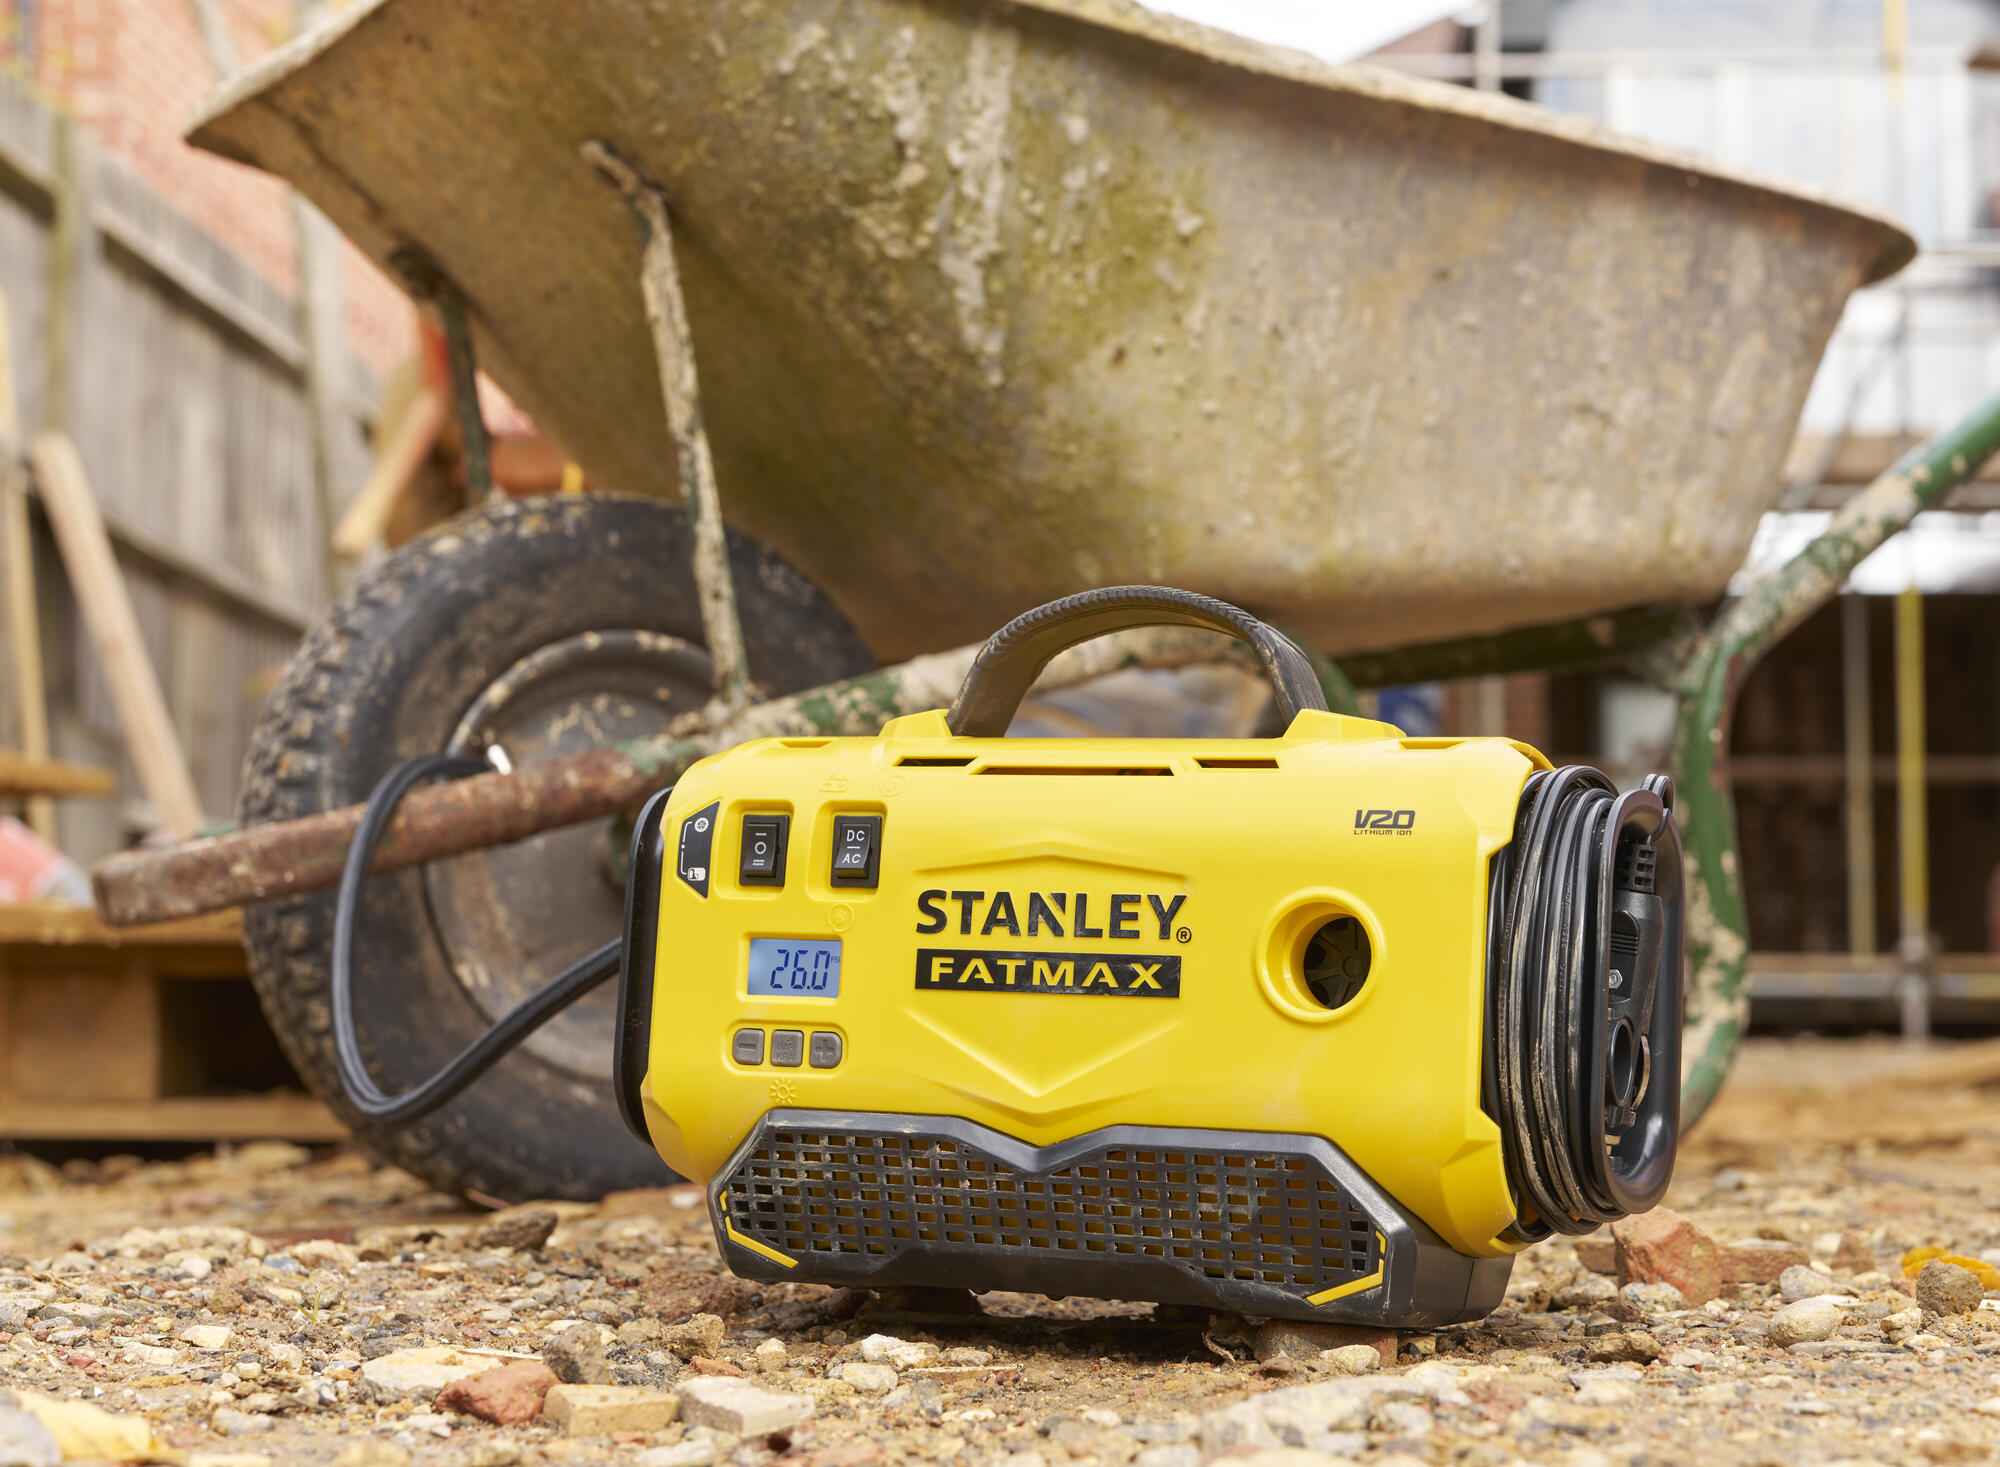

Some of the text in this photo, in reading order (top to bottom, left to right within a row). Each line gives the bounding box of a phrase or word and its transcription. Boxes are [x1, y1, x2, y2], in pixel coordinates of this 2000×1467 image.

[1354, 809, 1416, 829] V20
[846, 829, 865, 842] DC
[841, 852, 862, 864] AC
[770, 948, 831, 991] 26.0
[929, 956, 1164, 990] FATMAX
